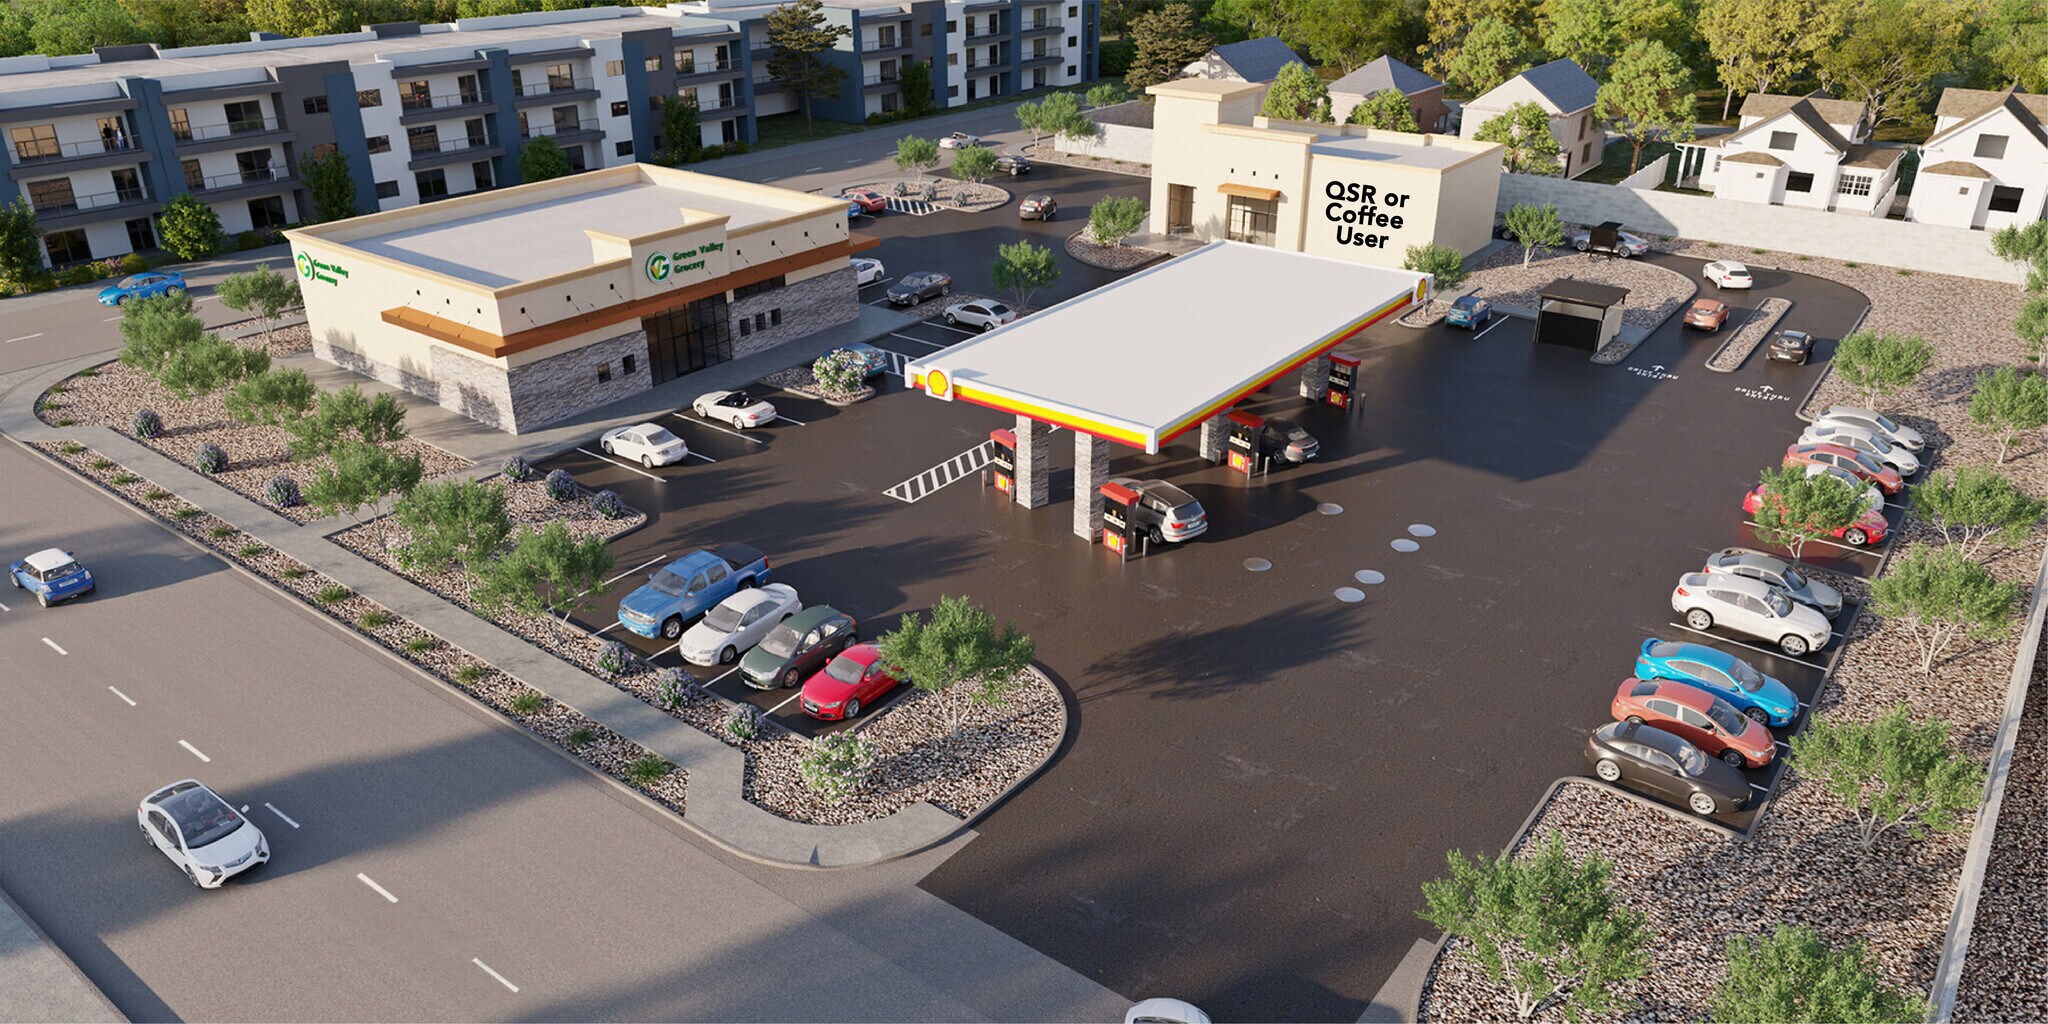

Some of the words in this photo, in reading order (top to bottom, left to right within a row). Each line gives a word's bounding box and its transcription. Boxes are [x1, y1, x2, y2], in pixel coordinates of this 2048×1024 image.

[1325, 181, 1377, 205] QSR
[1384, 193, 1410, 208] or
[1325, 202, 1404, 230] Coffee
[1336, 225, 1389, 249] User
[672, 250, 697, 261] Green
[699, 242, 724, 254] Valley
[673, 260, 705, 274] Grocery
